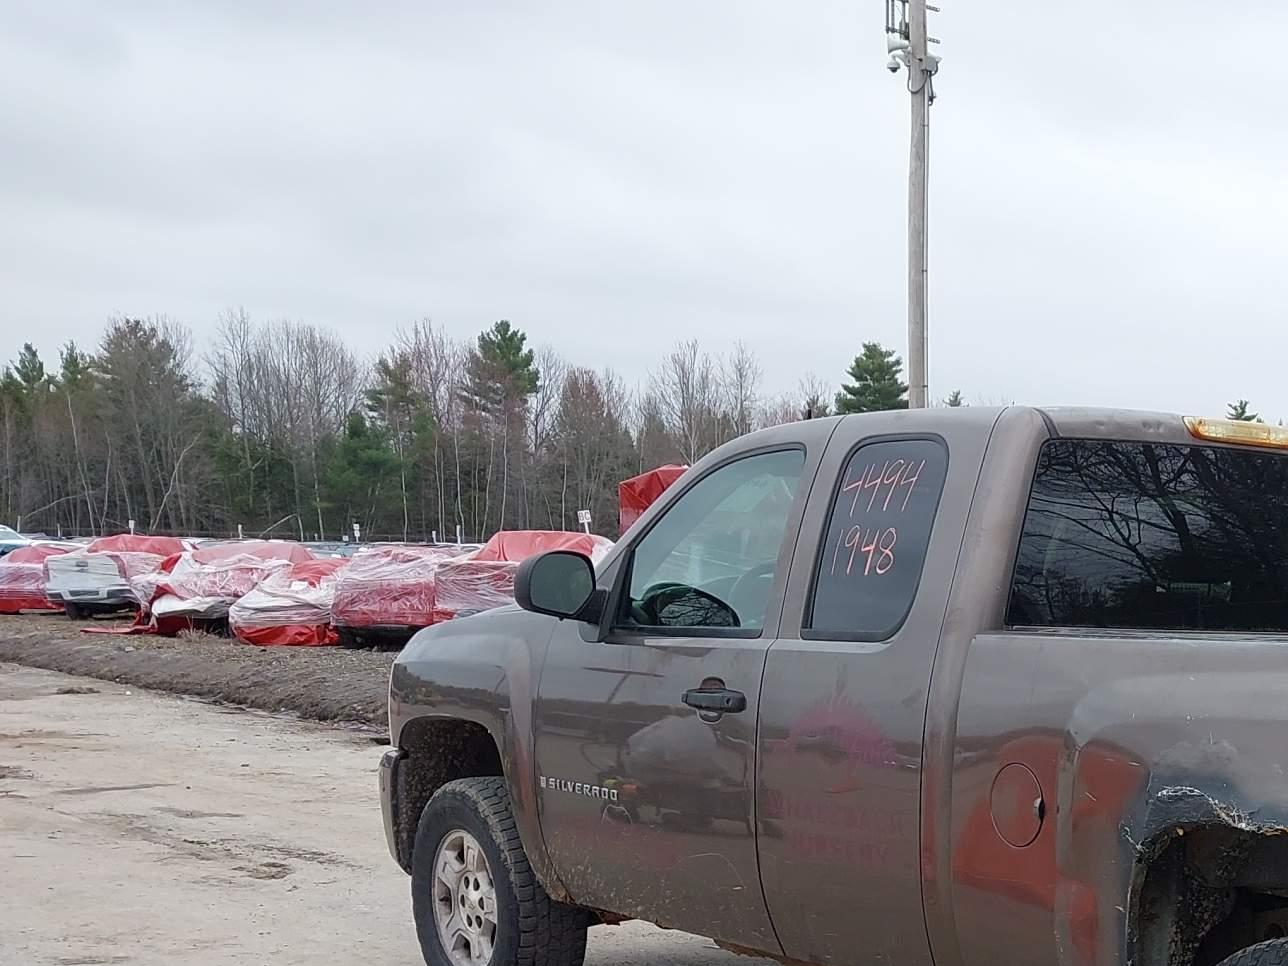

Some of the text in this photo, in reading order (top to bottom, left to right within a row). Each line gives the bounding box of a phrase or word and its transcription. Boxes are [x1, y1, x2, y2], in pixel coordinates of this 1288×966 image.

[843, 459, 926, 517] 4494
[831, 525, 897, 576] 1948
[548, 778, 618, 800] SILVERADO
